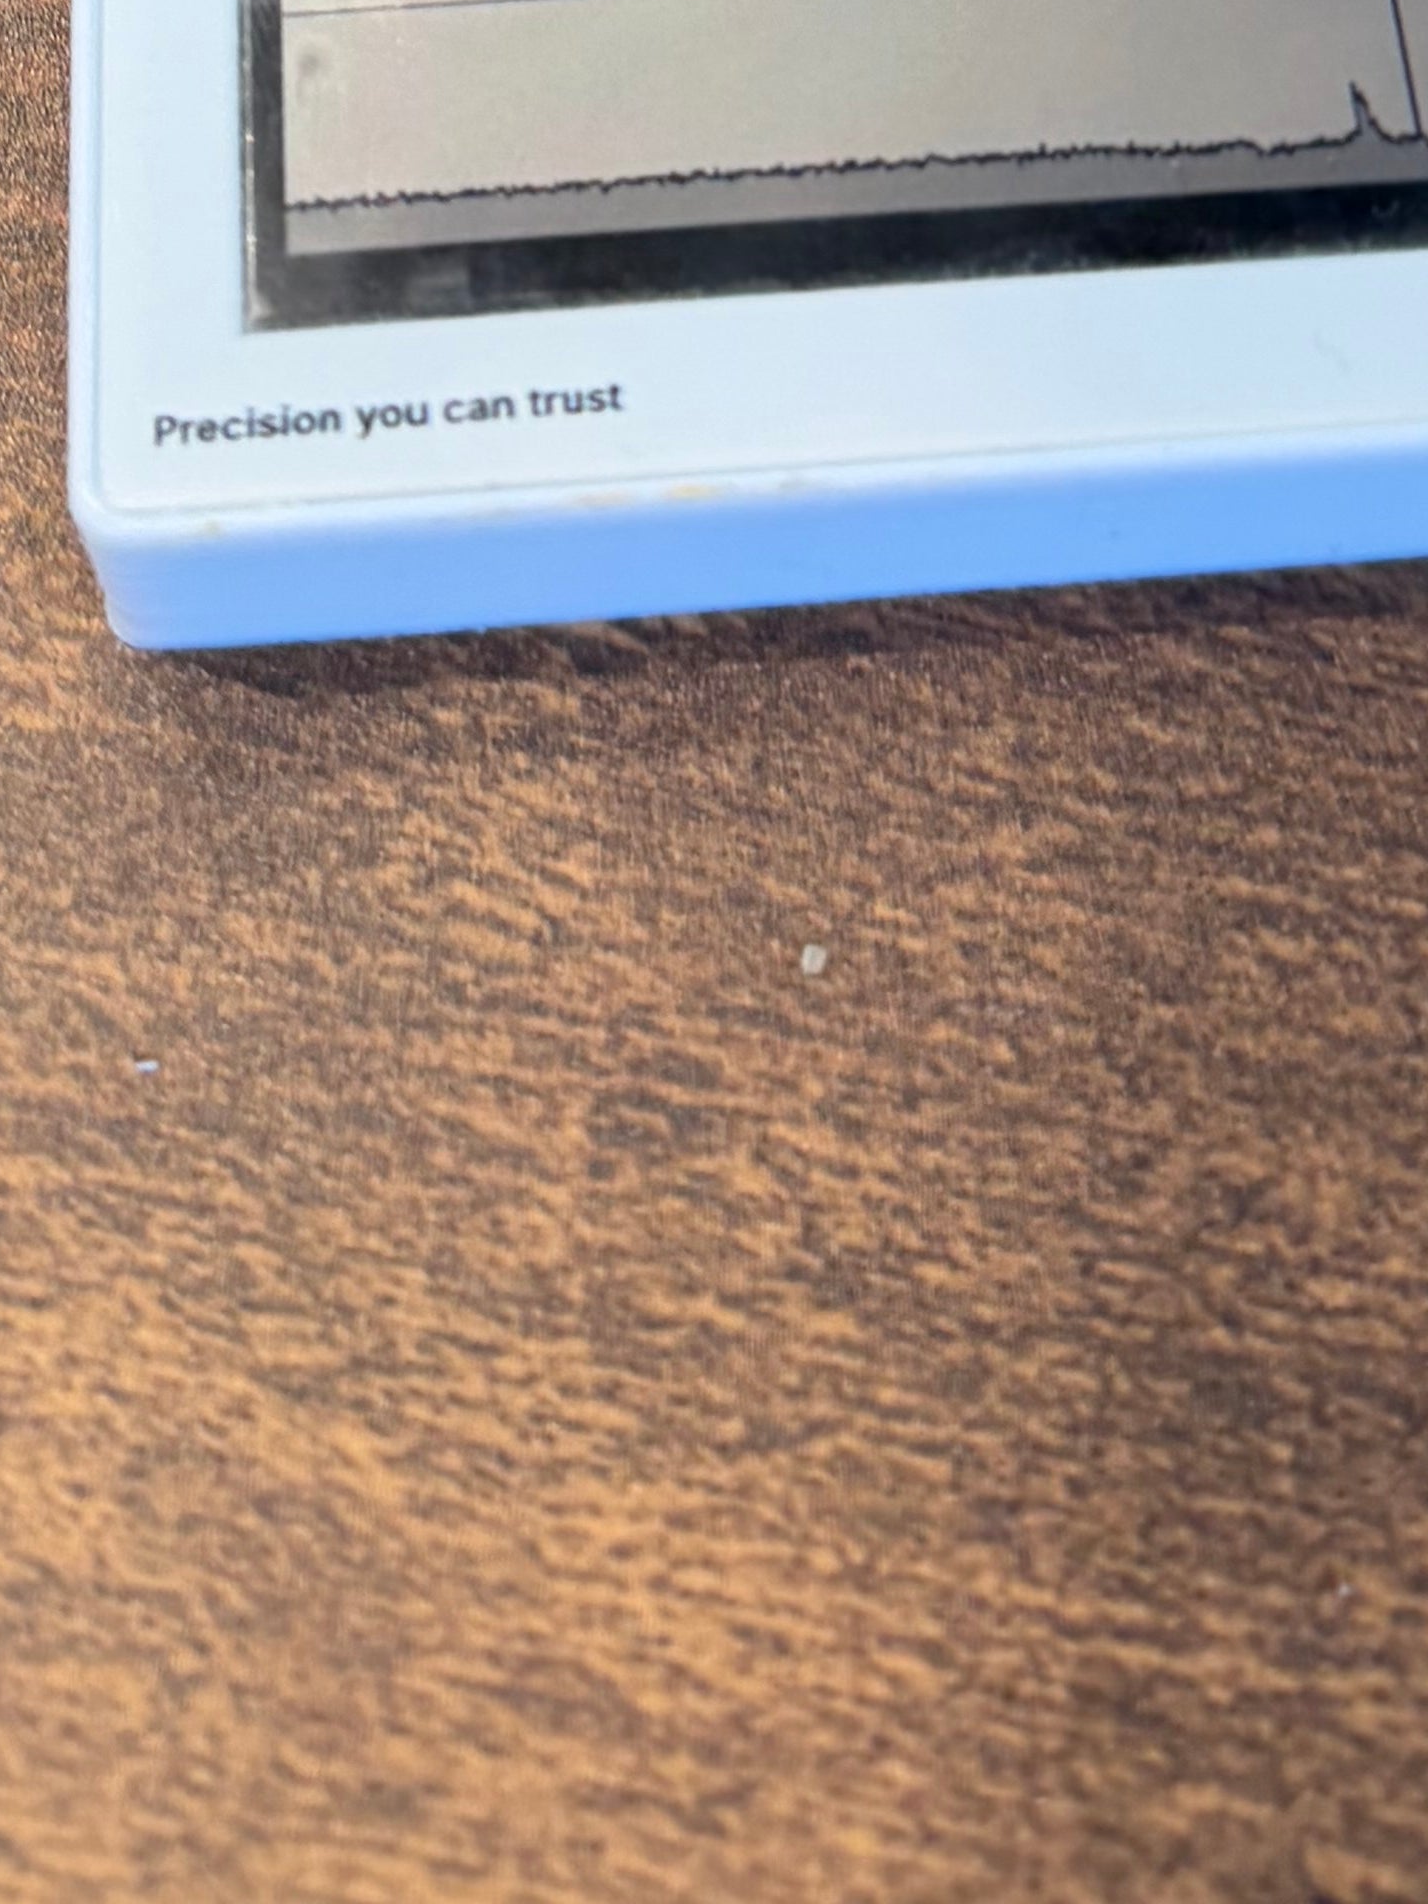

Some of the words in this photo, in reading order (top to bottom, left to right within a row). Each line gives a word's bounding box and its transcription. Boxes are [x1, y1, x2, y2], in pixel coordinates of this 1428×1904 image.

[152, 404, 343, 447] Precision
[355, 399, 430, 440] you
[442, 393, 516, 425] can
[527, 382, 624, 419] trust
